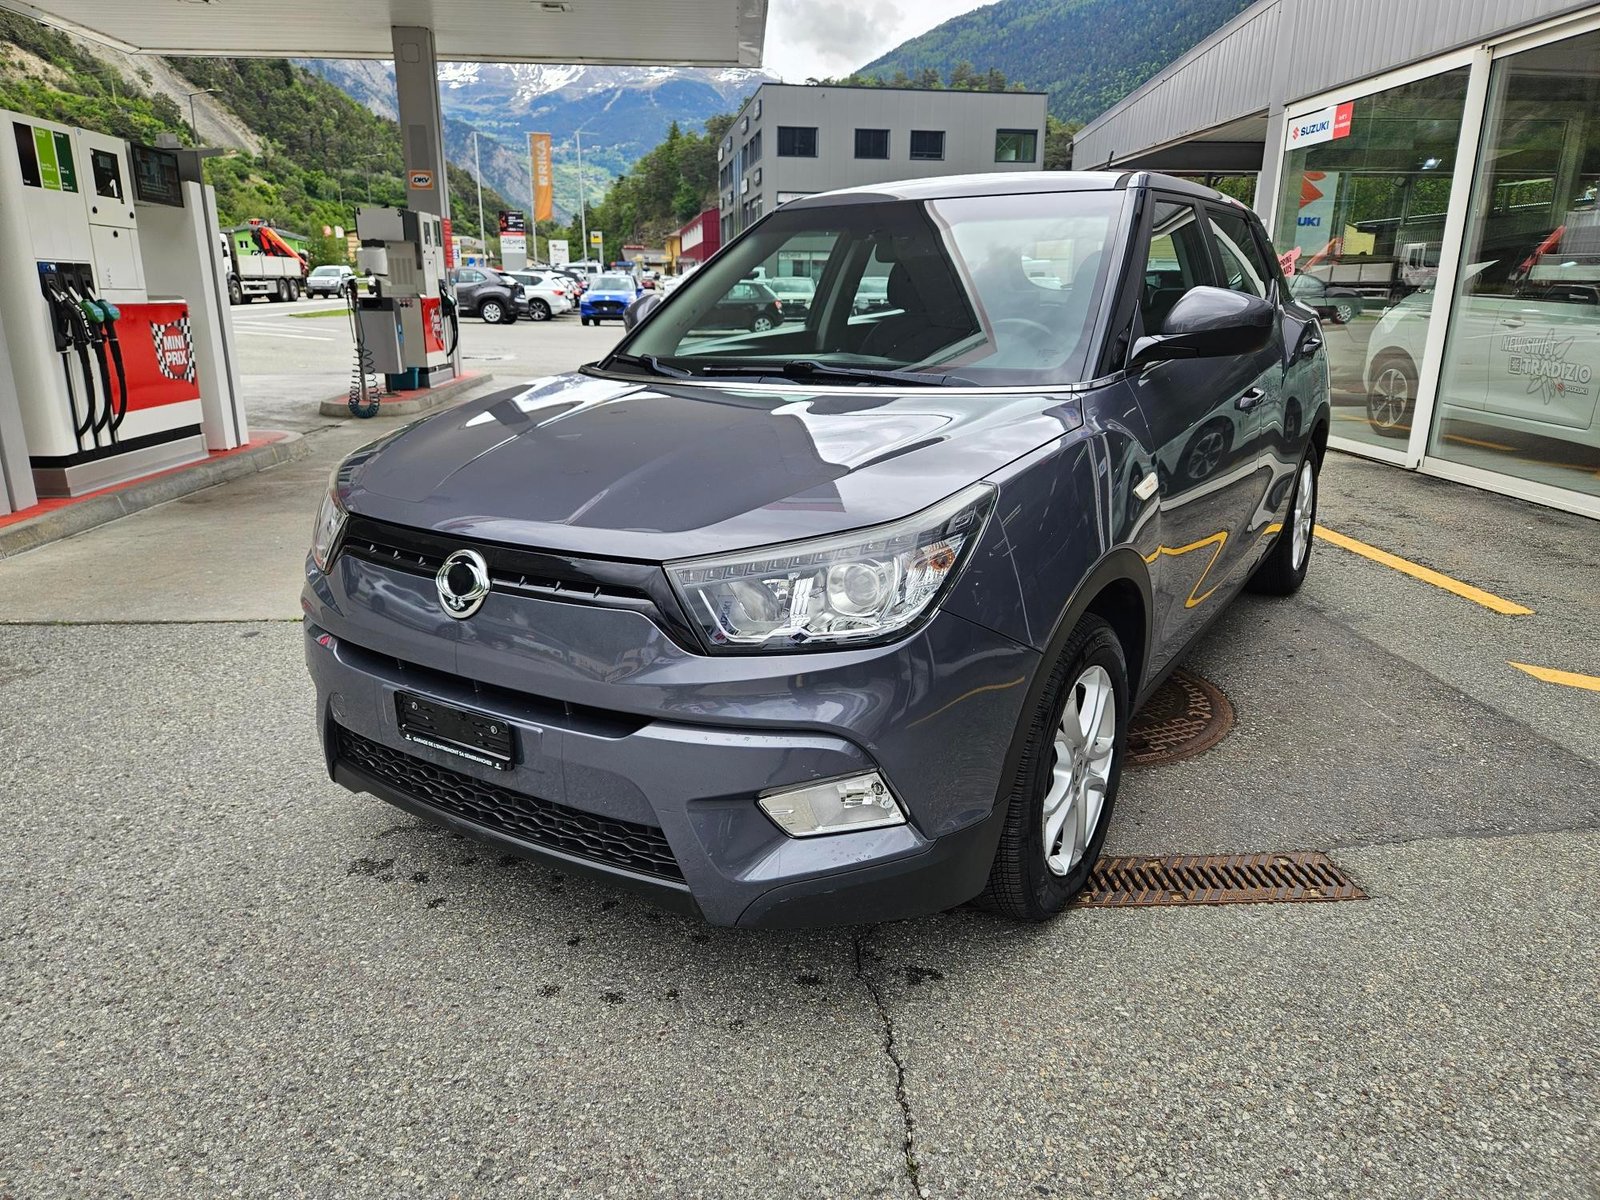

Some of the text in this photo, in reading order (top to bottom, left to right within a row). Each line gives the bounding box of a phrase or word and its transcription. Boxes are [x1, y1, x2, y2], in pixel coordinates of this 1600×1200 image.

[1300, 120, 1330, 137] SUZUKI
[413, 176, 430, 184] DKV
[109, 179, 119, 198] 1
[1297, 217, 1321, 227] UKI
[163, 335, 186, 350] MINI
[165, 350, 188, 366] PRIX
[1521, 357, 1592, 384] TRADIZIO
